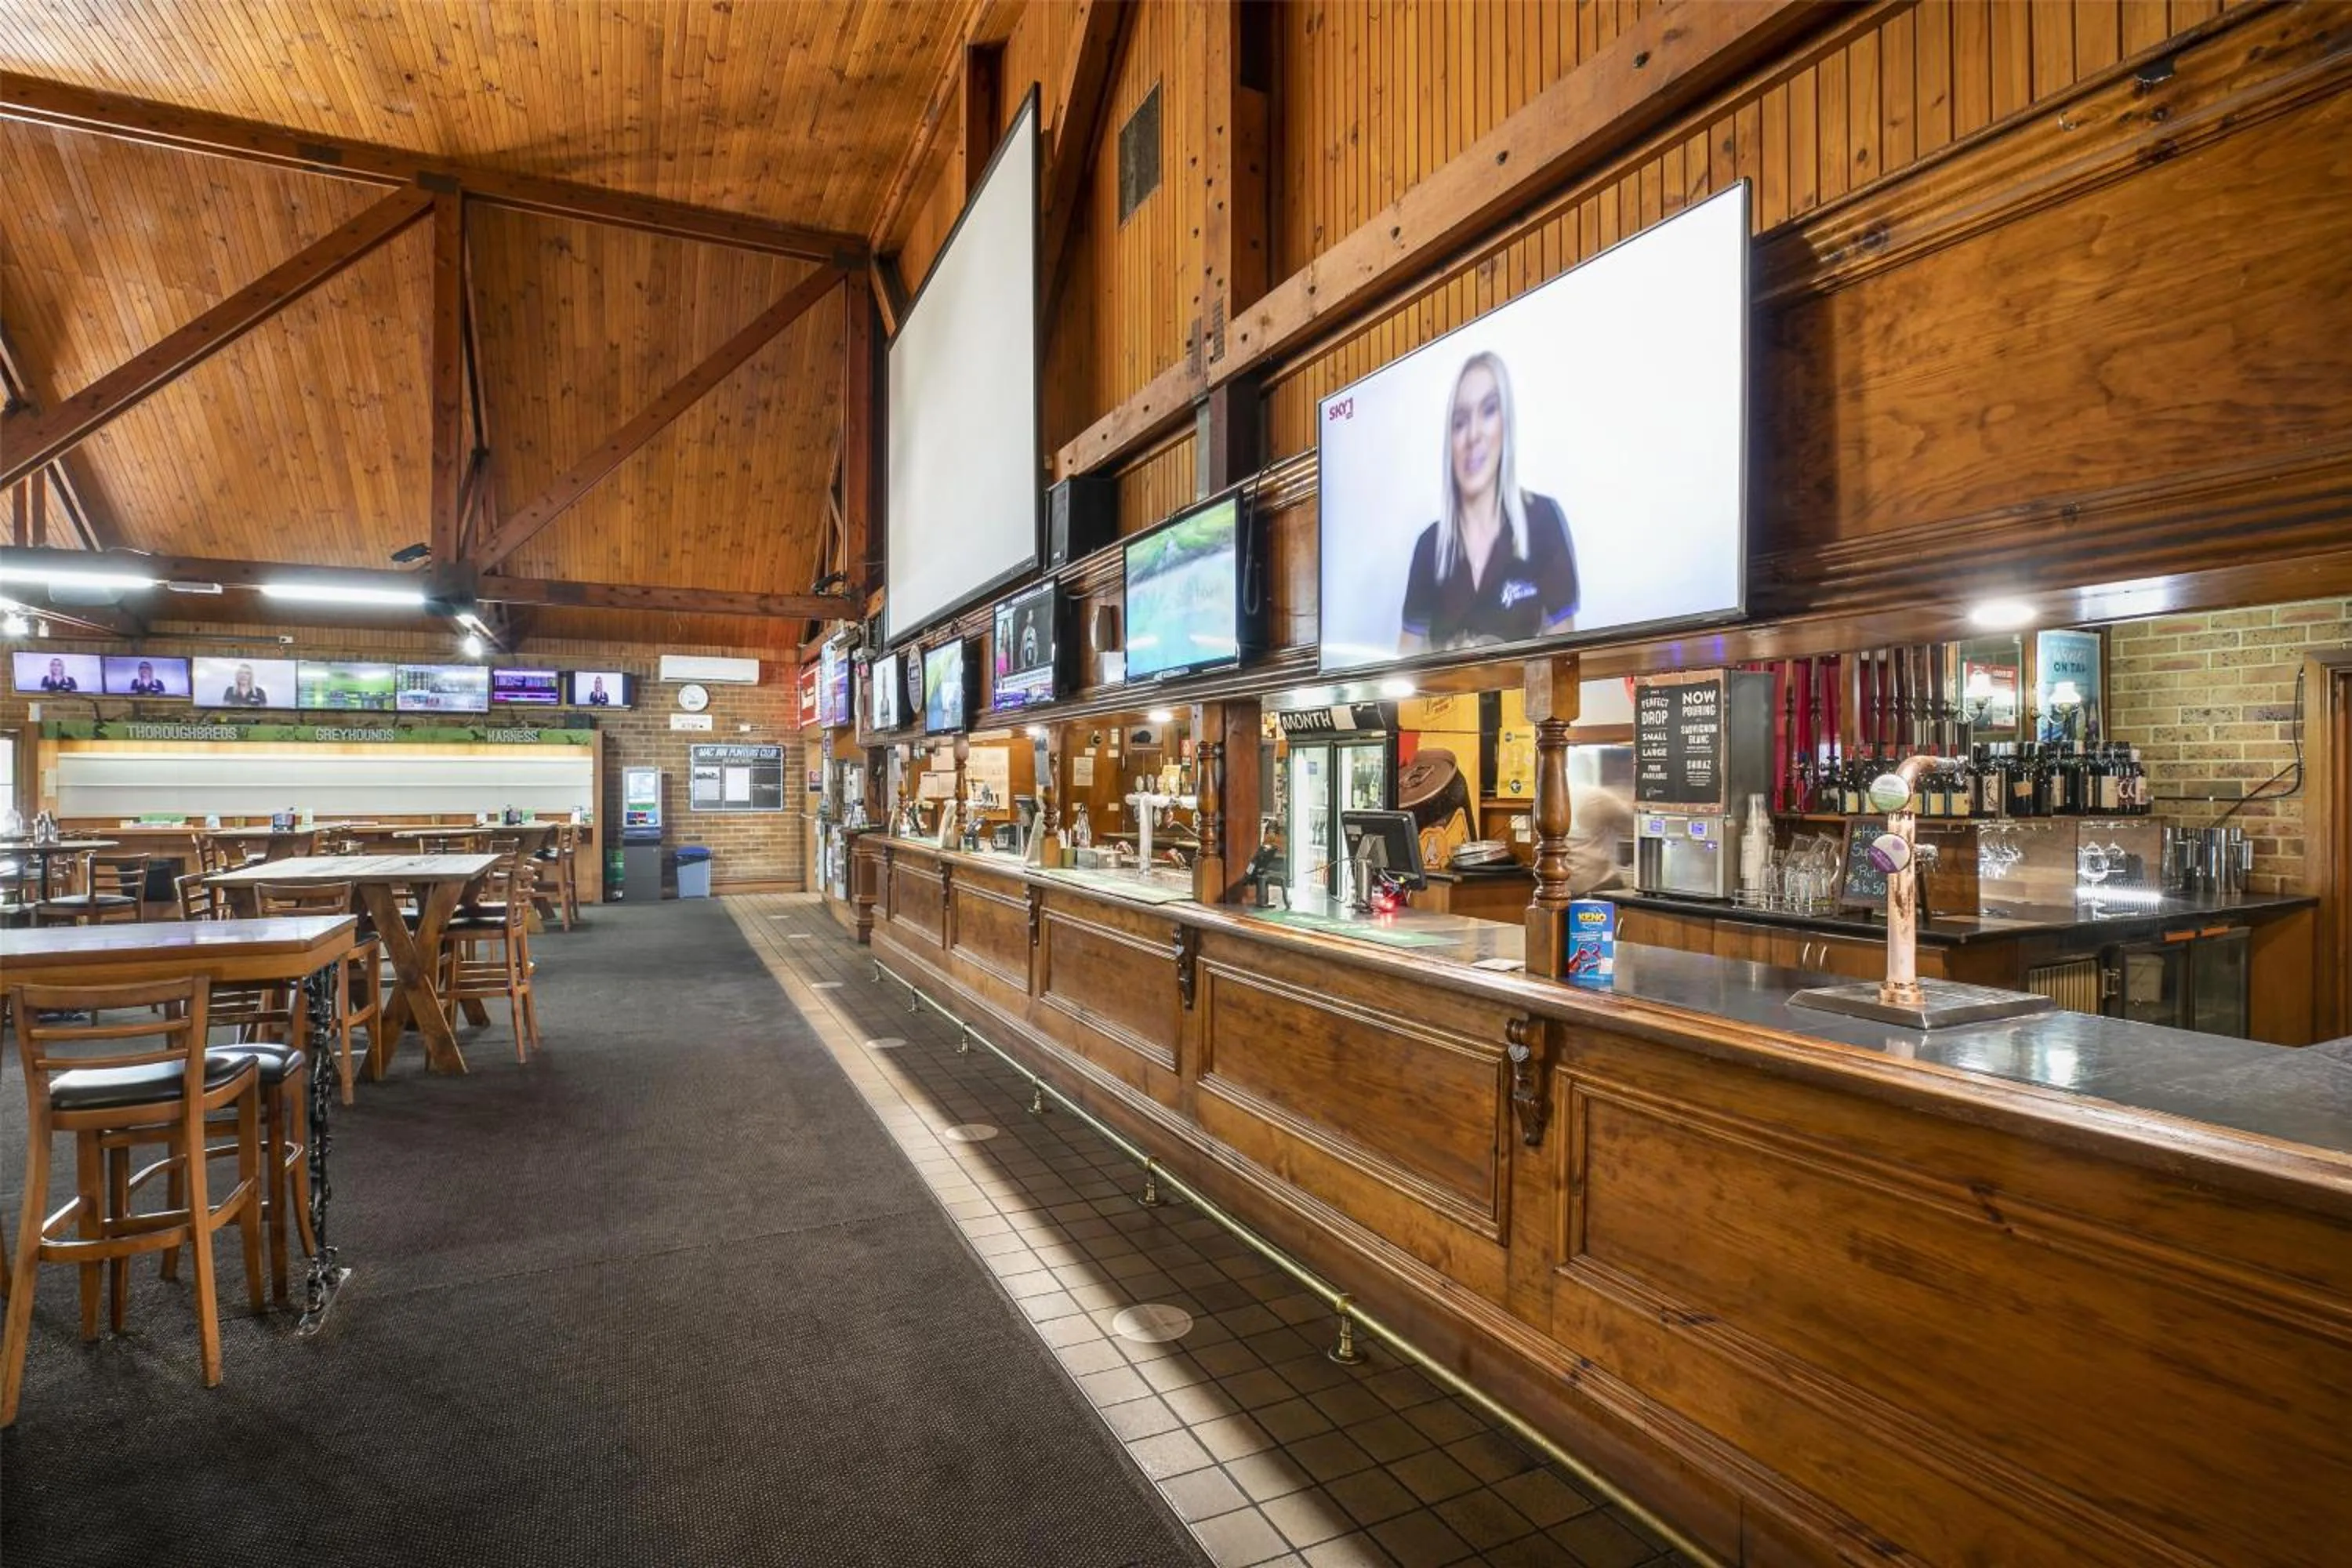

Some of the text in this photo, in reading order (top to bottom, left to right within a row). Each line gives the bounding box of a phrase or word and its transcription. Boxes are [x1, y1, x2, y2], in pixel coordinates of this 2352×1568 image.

[2053, 662, 2067, 672] ON
[1641, 697, 1669, 709] PERFECT
[1682, 690, 1716, 705] NOW
[1641, 710, 1669, 725] DROP
[1682, 706, 1716, 717] POURING
[1282, 710, 1332, 731] MONTH
[126, 725, 238, 739] THOROUGHBREDS
[316, 727, 394, 741] GREYHOUNDS
[488, 729, 539, 742] HARNESS
[1680, 724, 1718, 735] SAUVIGNON
[1642, 732, 1668, 741] SMALL
[1688, 735, 1710, 744] BLANC
[760, 749, 777, 758] CLUB
[1642, 748, 1668, 757] LARGE
[1578, 911, 1607, 923] KENO
